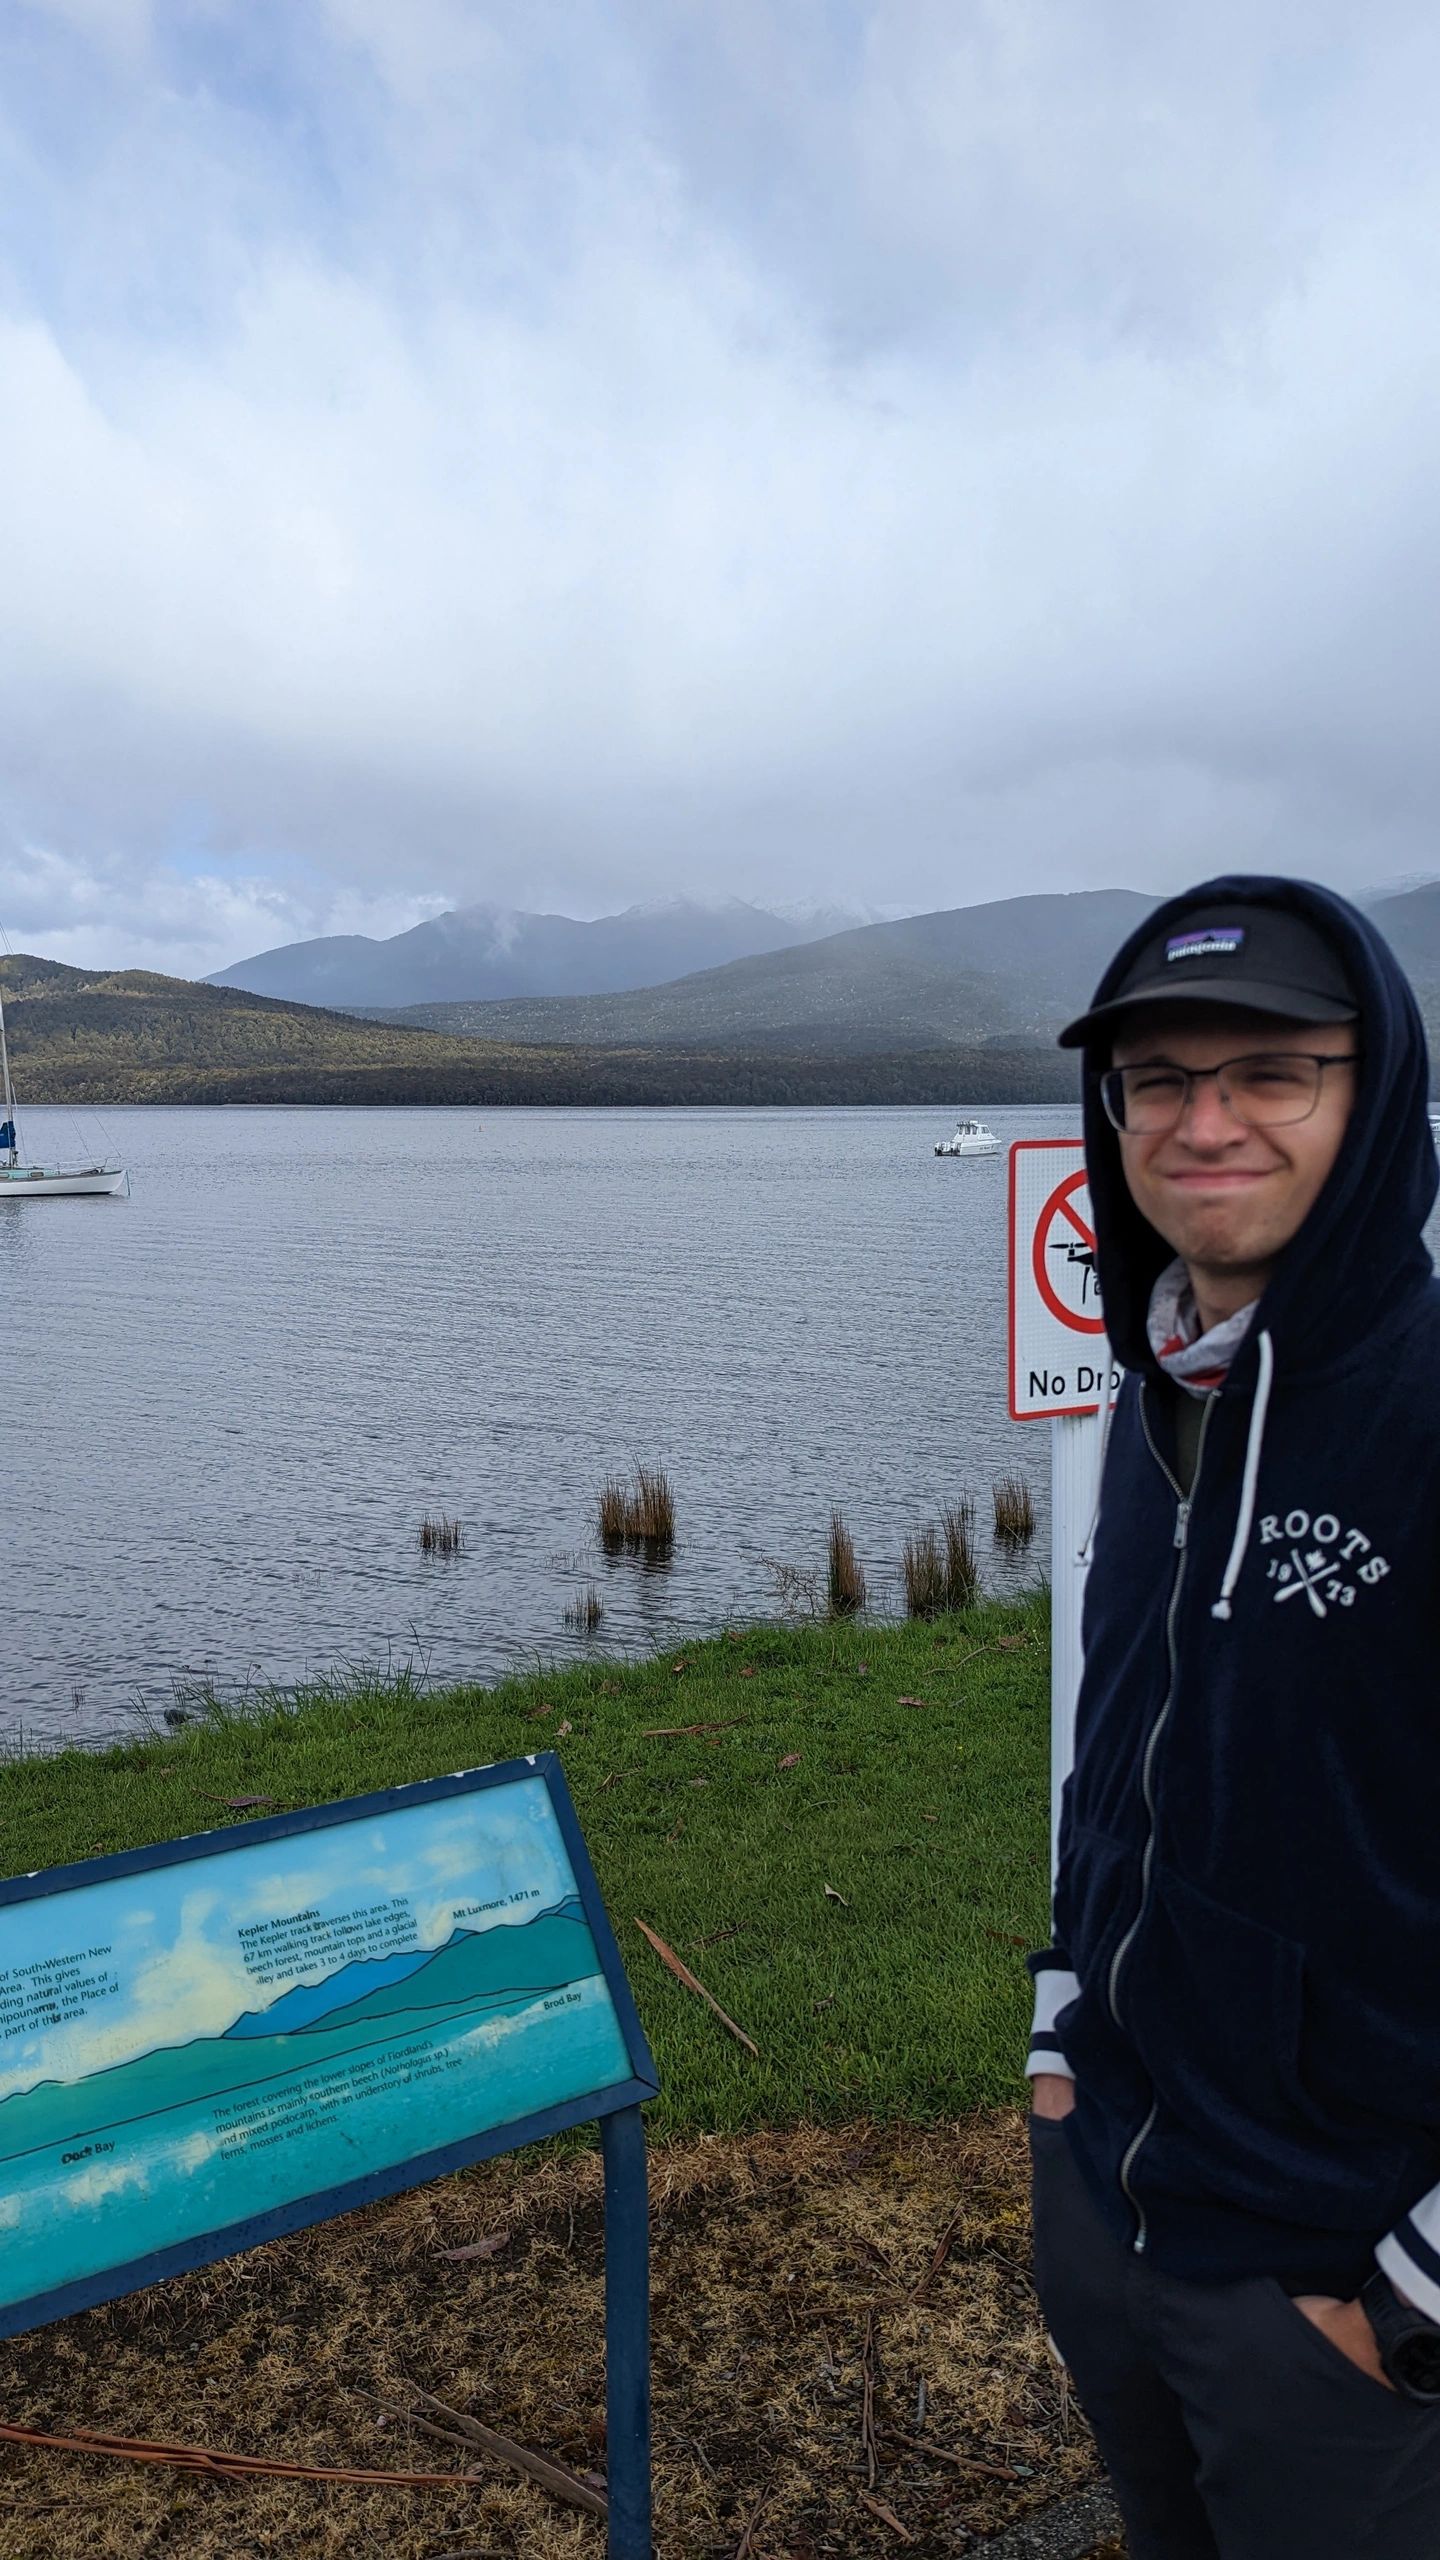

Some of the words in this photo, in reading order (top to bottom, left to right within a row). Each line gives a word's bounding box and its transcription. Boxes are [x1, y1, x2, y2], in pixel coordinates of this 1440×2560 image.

[1029, 1370, 1065, 1397] No
[1077, 1366, 1120, 1393] Dro
[1259, 1509, 1391, 1584] ROOTS
[1266, 1559, 1292, 1582] 19
[1326, 1579, 1357, 1606] 73
[238, 1923, 268, 1938] Kepler
[271, 1910, 320, 1928] Mountains
[240, 1940, 258, 1950] The
[260, 1931, 288, 1945] Kepler
[290, 1925, 312, 1936] track
[313, 1914, 350, 1931] traverses
[352, 1907, 368, 1918] this
[370, 1904, 389, 1914] area.
[391, 1897, 409, 1908] This
[453, 1909, 466, 1919] Mt
[468, 1899, 507, 1916] Luxmore,
[509, 1891, 529, 1903] 1471
[244, 1952, 255, 1962] 67
[257, 1947, 272, 1958] km
[274, 1937, 308, 1953] walking
[310, 1931, 332, 1943] track
[333, 1923, 363, 1937] follows
[365, 1916, 382, 1928] lake
[384, 1910, 410, 1923] edges,
[246, 1961, 272, 1975] beech
[275, 1953, 302, 1967] forest,
[305, 1941, 345, 1958] mountain
[347, 1935, 366, 1946] tops
[368, 1929, 383, 1940] and
[385, 1928, 390, 1936] a
[392, 1919, 417, 1933] glacial
[0, 1968, 9, 1981] of
[13, 1952, 86, 1978] South-Western
[89, 1946, 112, 1960] New
[256, 1973, 274, 1985] lley
[277, 1968, 294, 1980] and
[296, 1961, 318, 1973] takes
[320, 1958, 326, 1966] 3
[328, 1954, 337, 1964] to
[339, 1951, 345, 1960] 4
[348, 1947, 366, 1959] days
[368, 1942, 377, 1952] to
[379, 1932, 418, 1949] complete
[0, 1983, 25, 1996] Area.
[31, 1976, 52, 1987] This
[55, 1967, 80, 1983] gives
[0, 1996, 23, 2010] ding
[27, 1986, 62, 2003] natural
[64, 1976, 95, 1992] values
[98, 1971, 108, 1982] of
[61, 1995, 79, 2007] the
[81, 1988, 106, 2001] Place
[109, 1982, 119, 1993] of
[543, 1999, 565, 2010] Brod
[567, 1991, 582, 2003] Bay
[5, 2024, 25, 2040] part
[29, 2017, 40, 2030] of
[63, 2009, 88, 2020] area.
[213, 2108, 231, 2120] The
[233, 2098, 260, 2112] forest
[262, 2083, 302, 2104] covering
[304, 2078, 319, 2090] the
[320, 2070, 346, 2085] lower
[348, 2060, 375, 2075] slopes
[377, 2055, 387, 2066] of
[388, 2040, 434, 2062] Fiordland's
[215, 2110, 266, 2134] mountains
[268, 2106, 276, 2118] is
[278, 2097, 308, 2114] mainly
[309, 2081, 350, 2101] southern
[352, 2072, 379, 2087] beech
[380, 2055, 432, 2080] (Nothofagus
[434, 2047, 449, 2062] sp.)
[221, 2133, 237, 2146] nd
[239, 2122, 270, 2139] mixed
[271, 2109, 318, 2130] podocarp,
[320, 2099, 340, 2112] with
[342, 2094, 354, 2105] an
[355, 2080, 402, 2101] understory
[403, 2074, 413, 2085] of
[414, 2065, 444, 2081] shrubs,
[446, 2058, 463, 2069] tree
[95, 2141, 115, 2153] Bay
[220, 2144, 247, 2161] ferns,
[250, 2133, 285, 2151] mosses
[286, 2125, 304, 2137] and
[306, 2115, 339, 2132] lichens.
